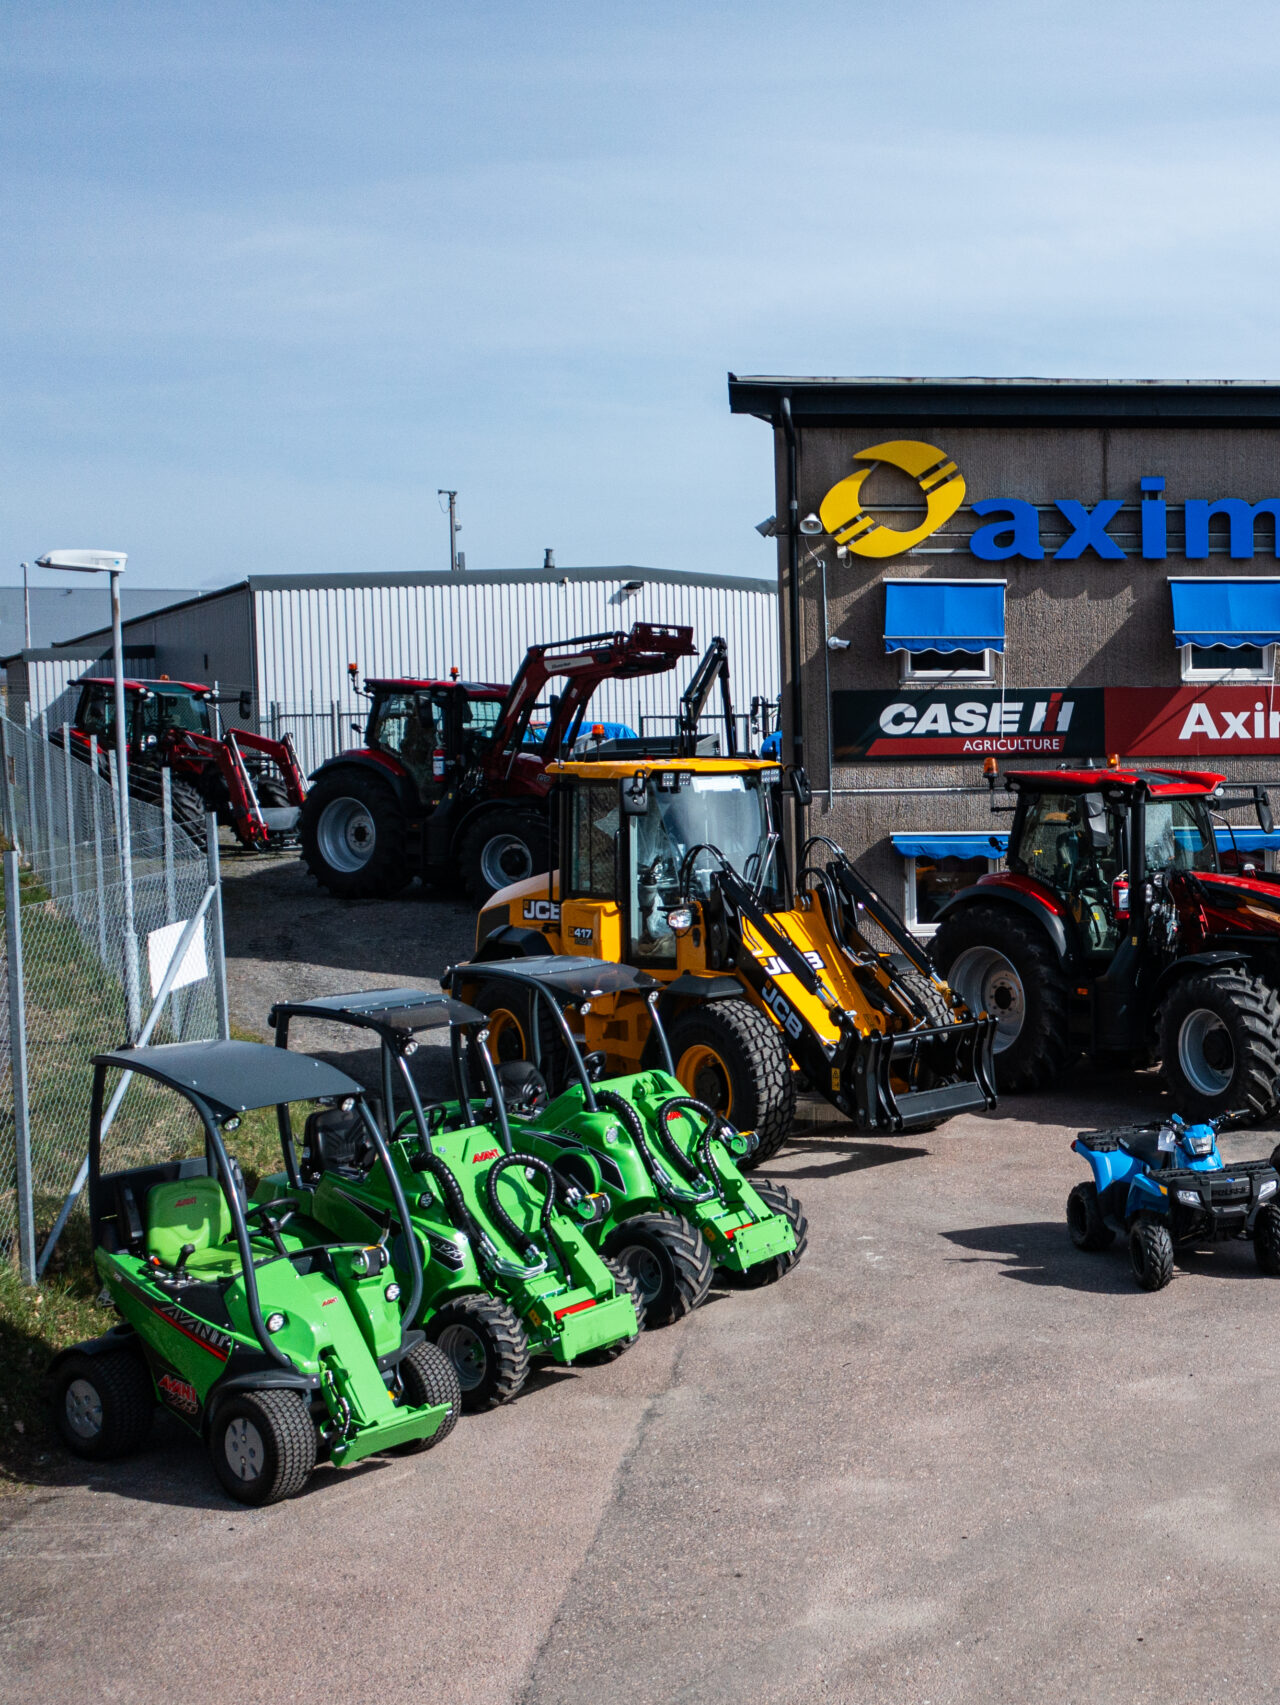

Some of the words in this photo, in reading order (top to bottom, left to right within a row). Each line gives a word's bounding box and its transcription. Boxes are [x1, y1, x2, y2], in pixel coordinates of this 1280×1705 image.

[879, 702, 1024, 736] CASE
[963, 738, 1060, 752] AGRICULTURE
[574, 927, 592, 938] 417
[761, 986, 803, 1039] JCB
[472, 1148, 501, 1164] AVANT
[158, 1374, 197, 1404] AVANT
